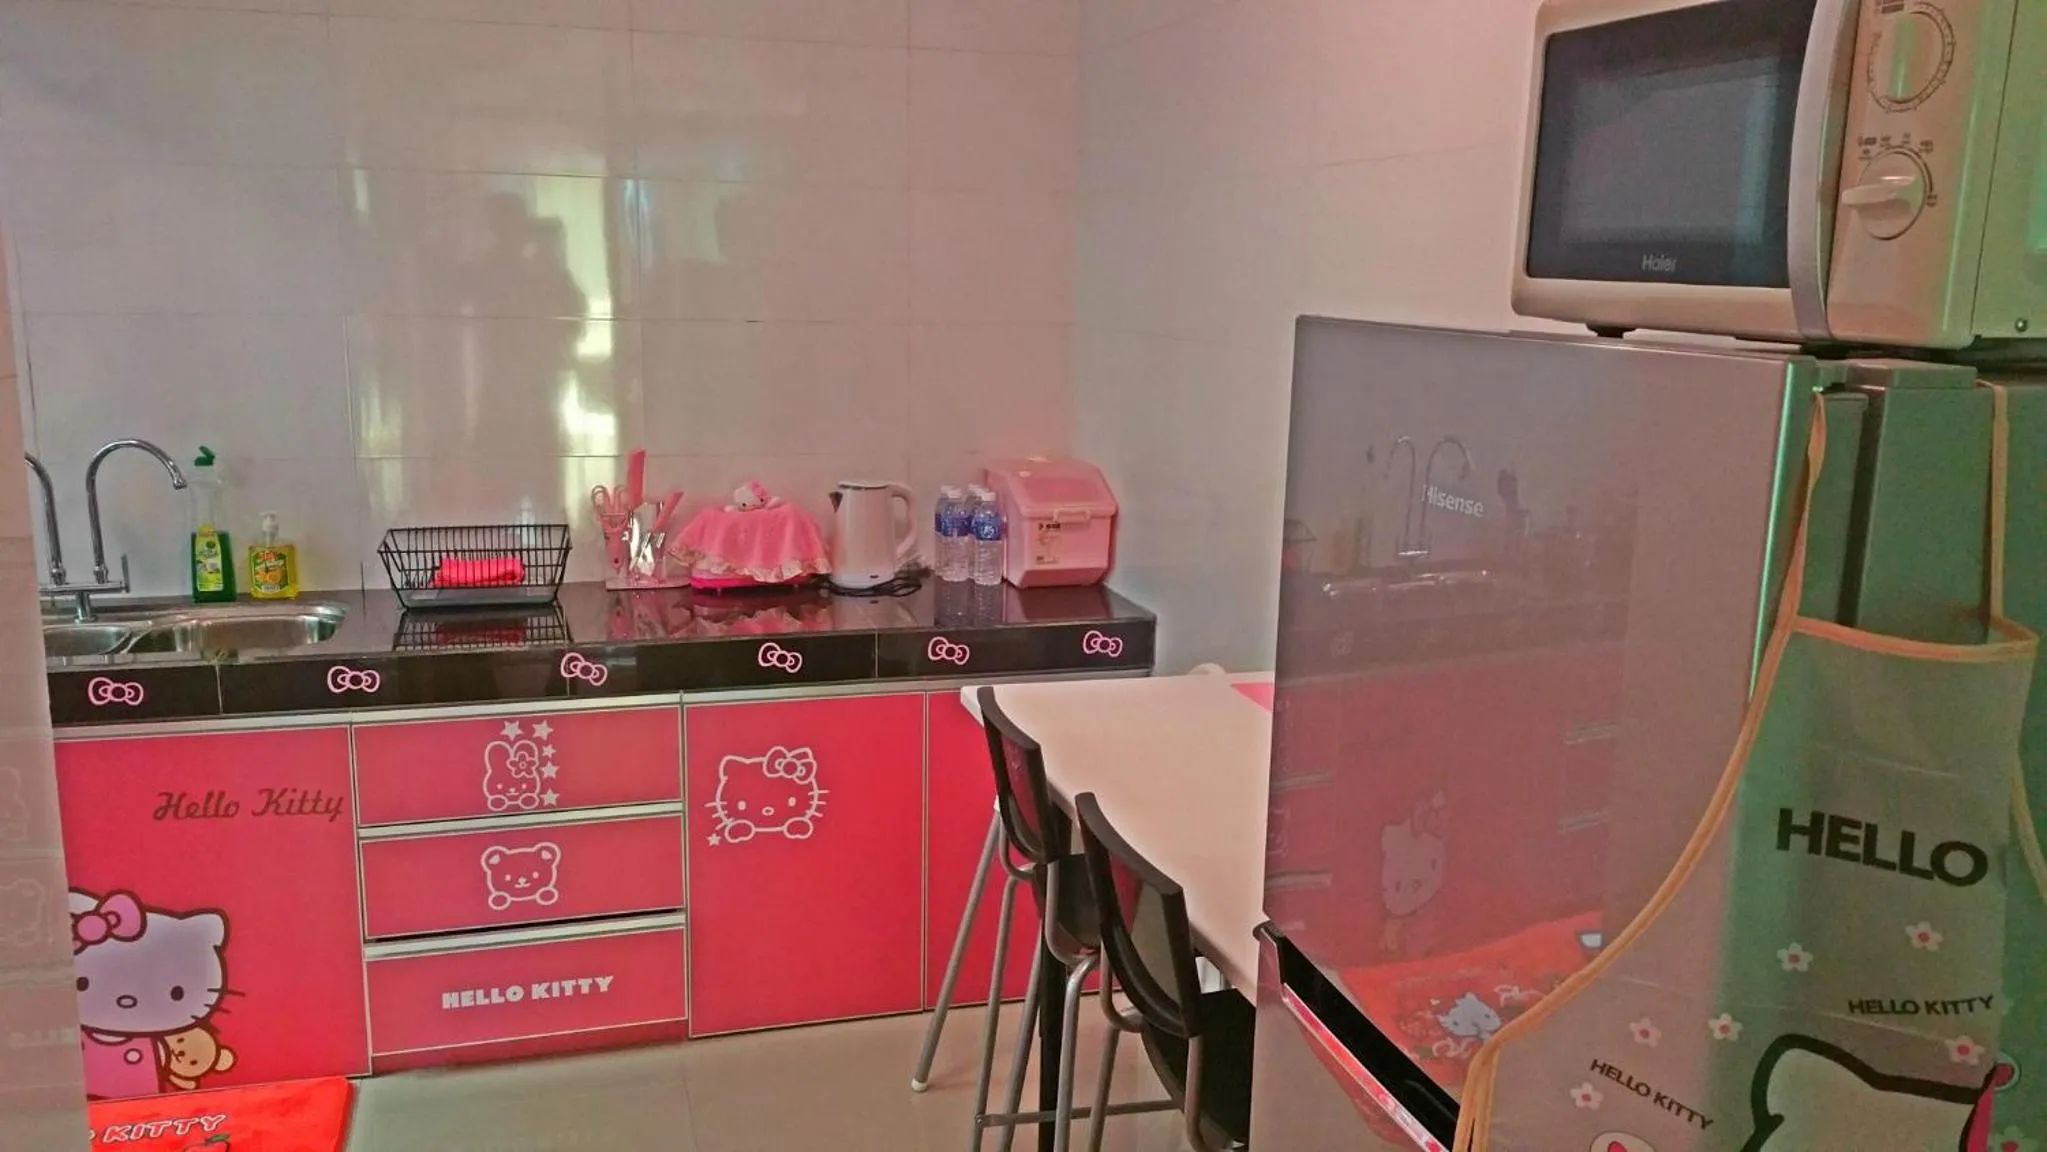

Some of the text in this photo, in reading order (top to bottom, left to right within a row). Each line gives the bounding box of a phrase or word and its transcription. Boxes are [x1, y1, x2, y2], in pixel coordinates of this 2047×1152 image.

[1641, 253, 1677, 273] Haier
[1421, 483, 1484, 518] Hisense
[153, 788, 344, 822] Hello Kitty
[1775, 807, 1989, 887] HELLO
[442, 975, 615, 1010] HELLO KITTY
[1848, 995, 1994, 1016] HELLO KITTY
[1589, 1059, 1714, 1131] HELLO KITTY
[103, 1114, 227, 1144] KITTY
